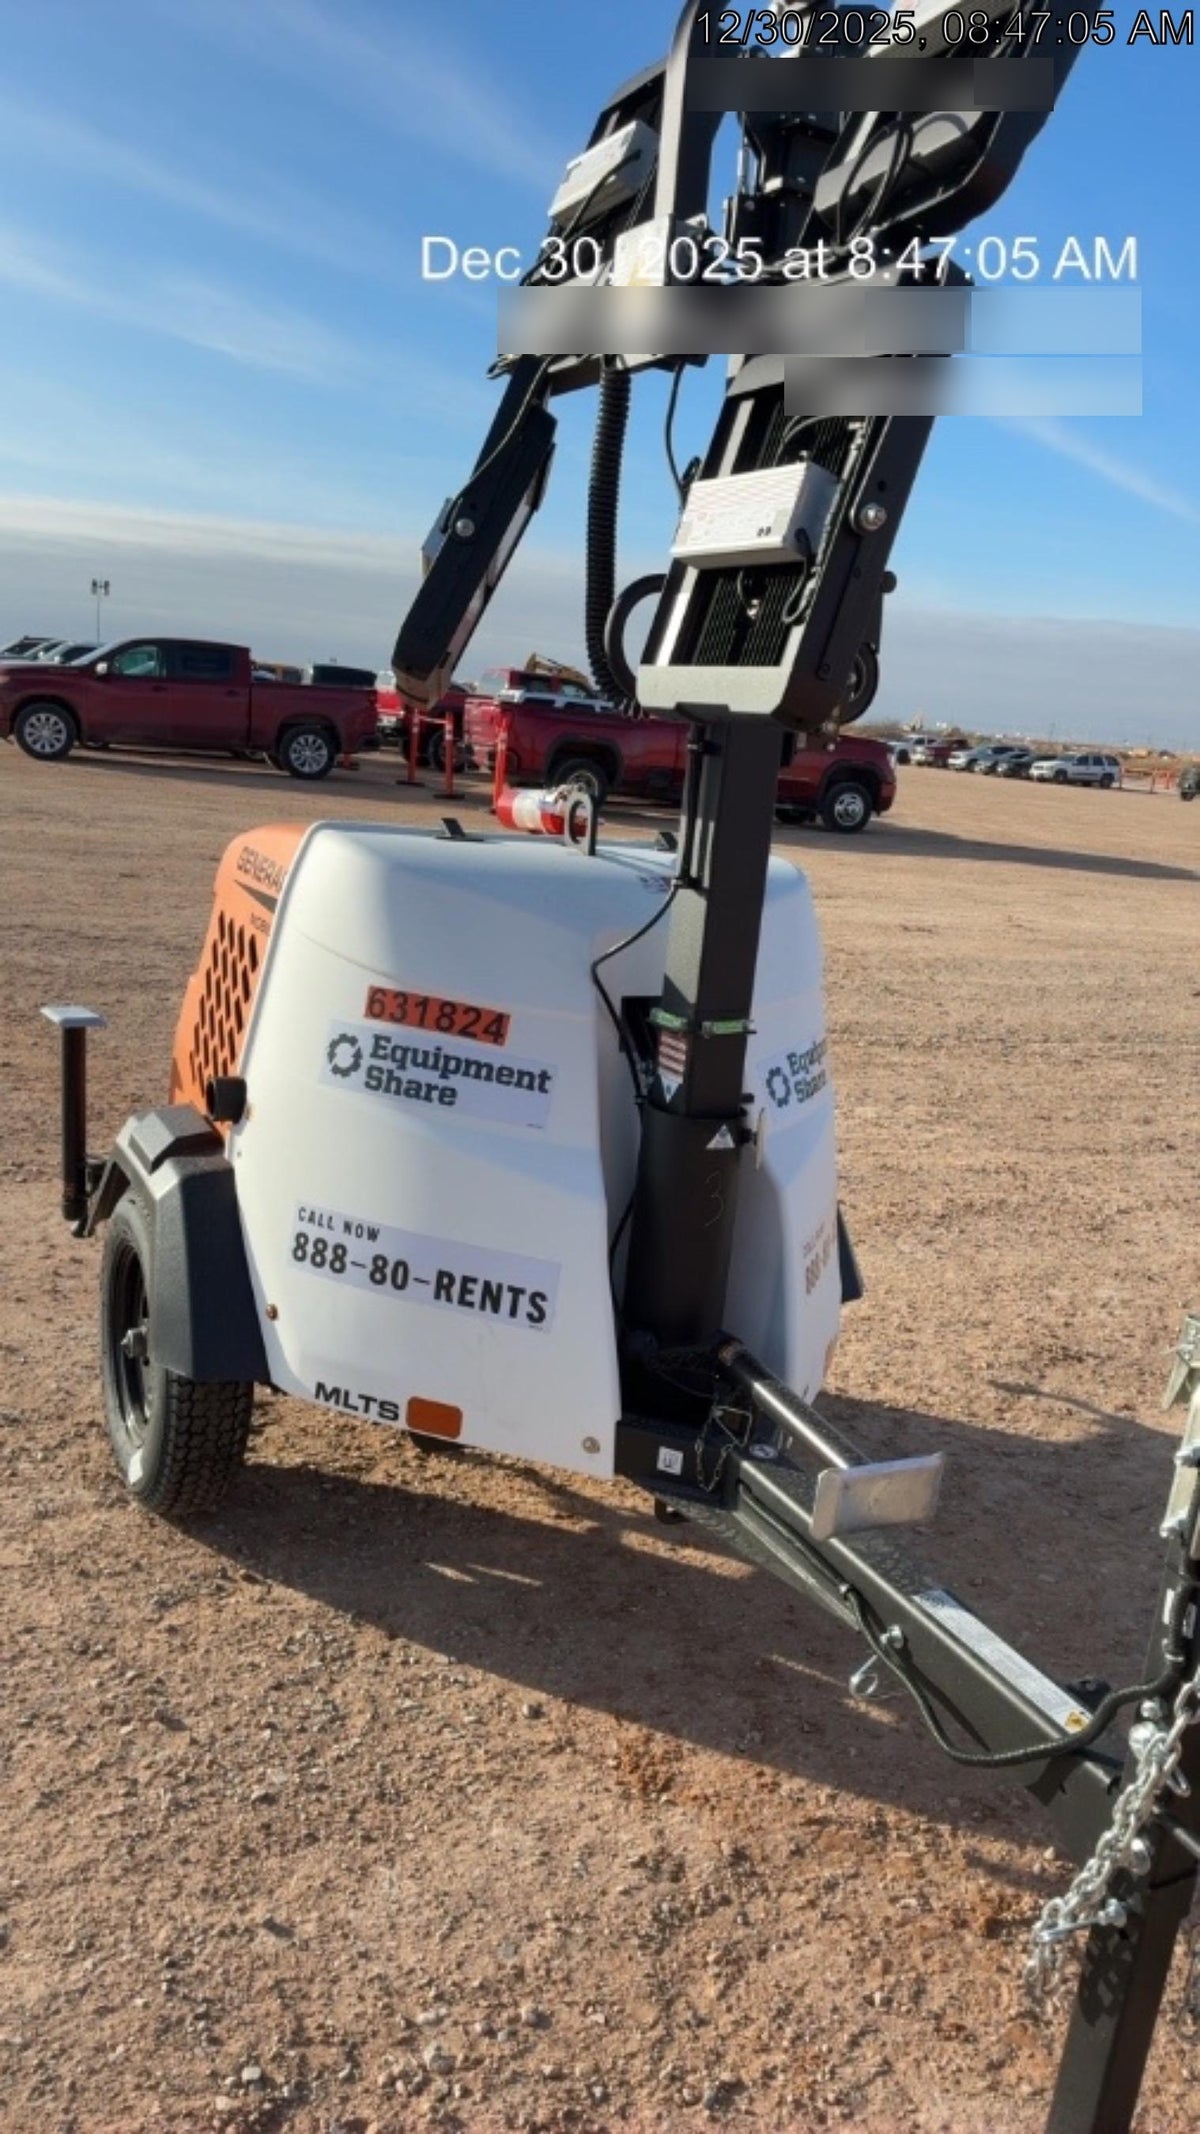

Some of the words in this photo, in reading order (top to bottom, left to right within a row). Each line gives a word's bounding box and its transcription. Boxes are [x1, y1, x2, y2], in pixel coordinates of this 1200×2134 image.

[367, 988, 506, 1046] 631824
[364, 1063, 458, 1107] Share
[369, 1033, 553, 1094] Equipment
[297, 1206, 335, 1231] CALL
[343, 1219, 381, 1243] NOW
[291, 1231, 549, 1325] 888-80-RENTS
[314, 1381, 400, 1421] MLTS
